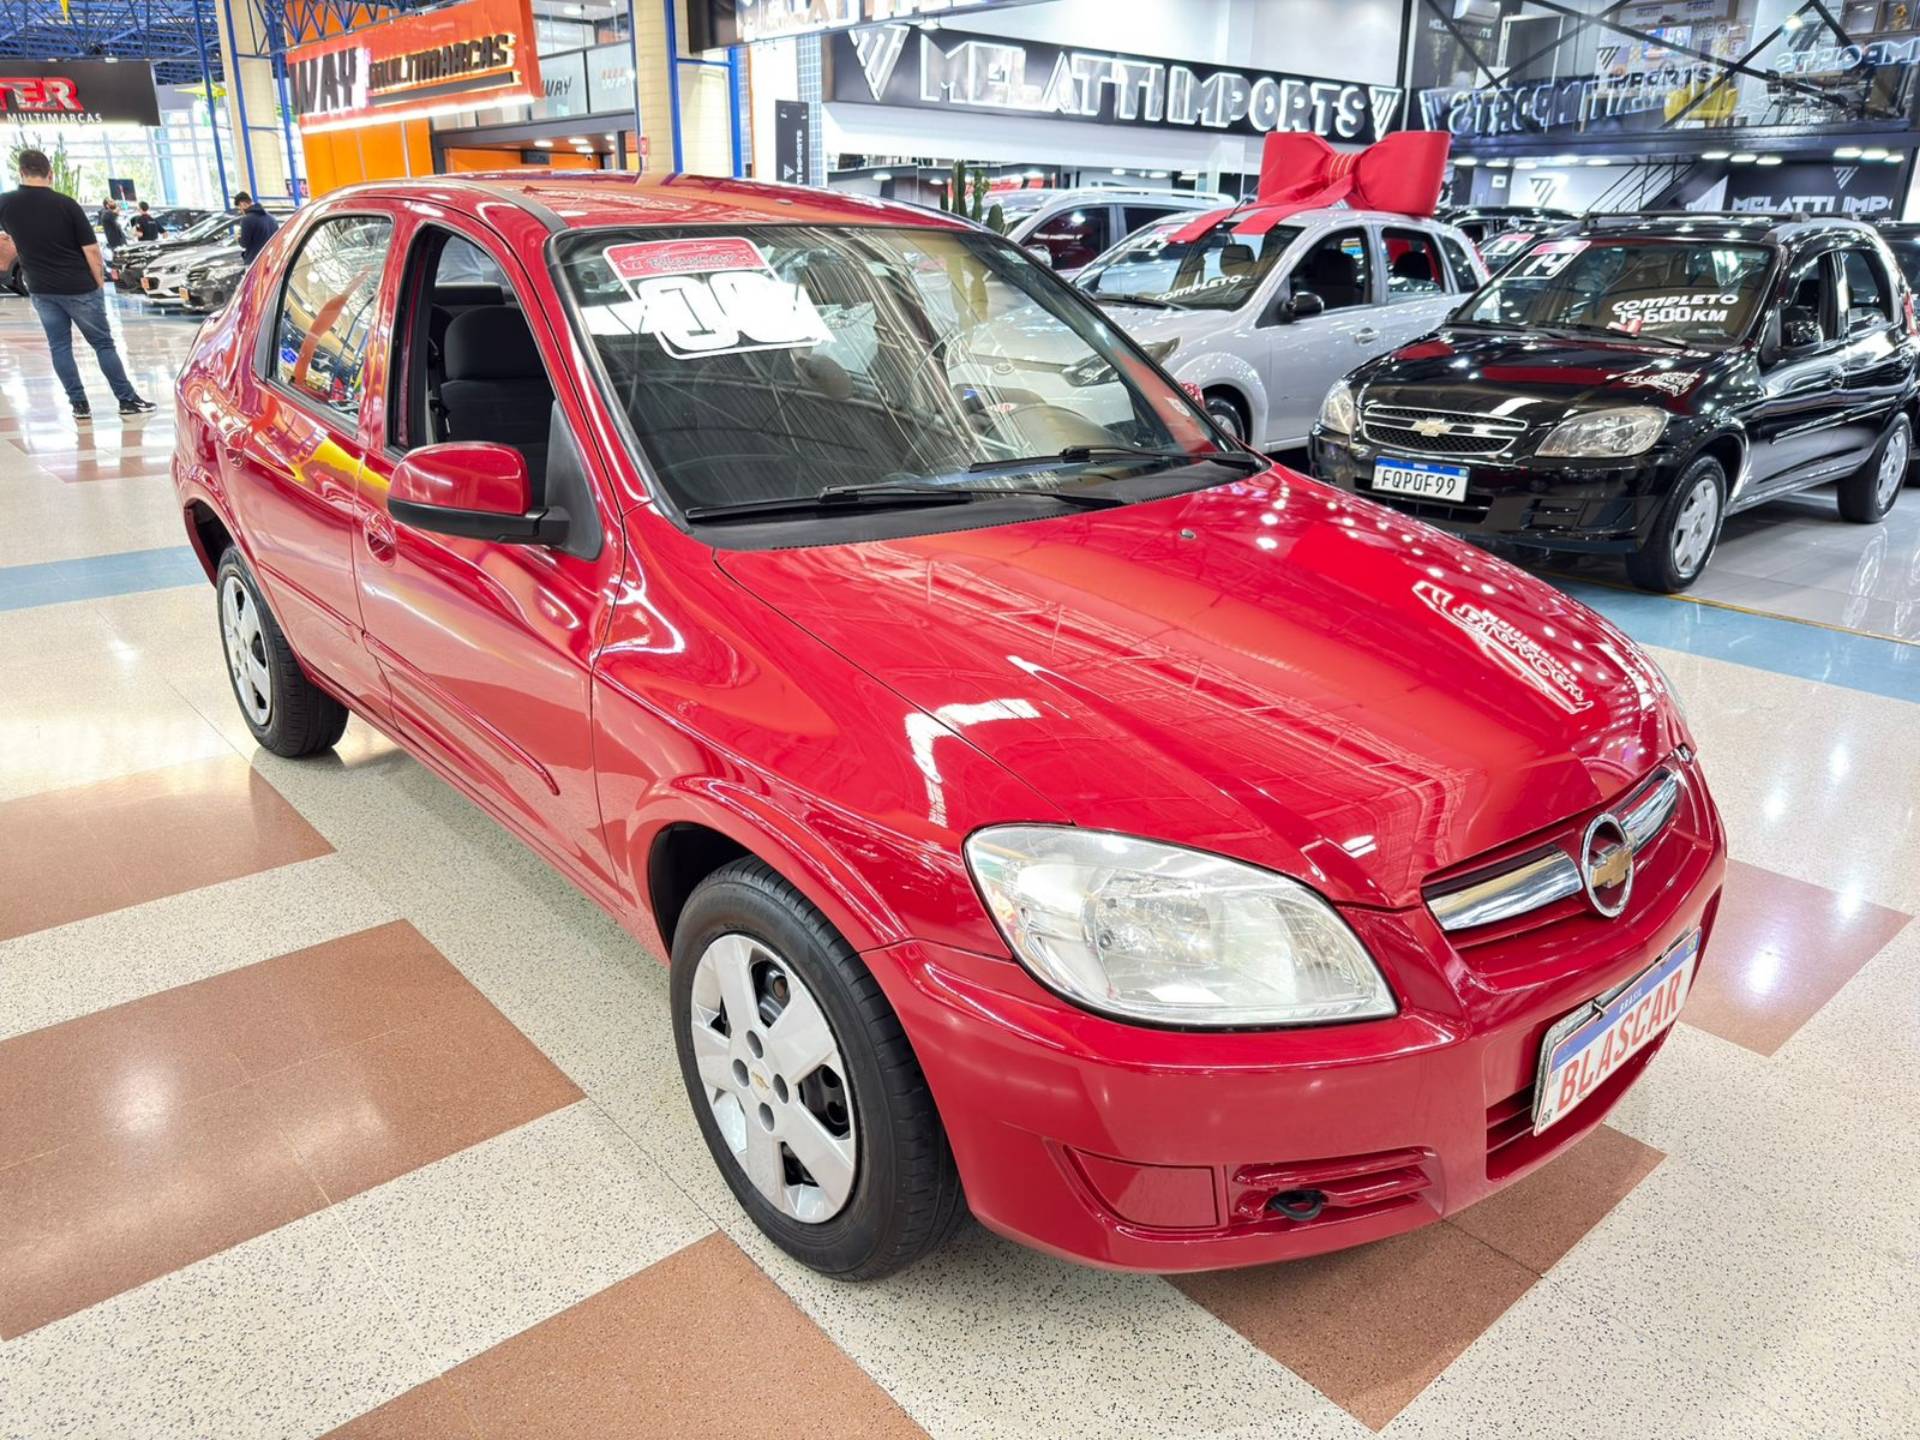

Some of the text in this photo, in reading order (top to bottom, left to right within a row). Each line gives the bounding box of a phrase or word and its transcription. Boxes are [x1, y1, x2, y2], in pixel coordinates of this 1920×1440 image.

[289, 47, 357, 115] WAY
[369, 34, 511, 90] MULTIMARCAS
[6, 112, 103, 124] MULTIMARCAS
[1167, 65, 1368, 138] IMPORTS
[1731, 196, 1836, 213] MELATTI
[1612, 294, 1739, 312] COMPLETO
[1557, 968, 1683, 1113] BLASCAR
